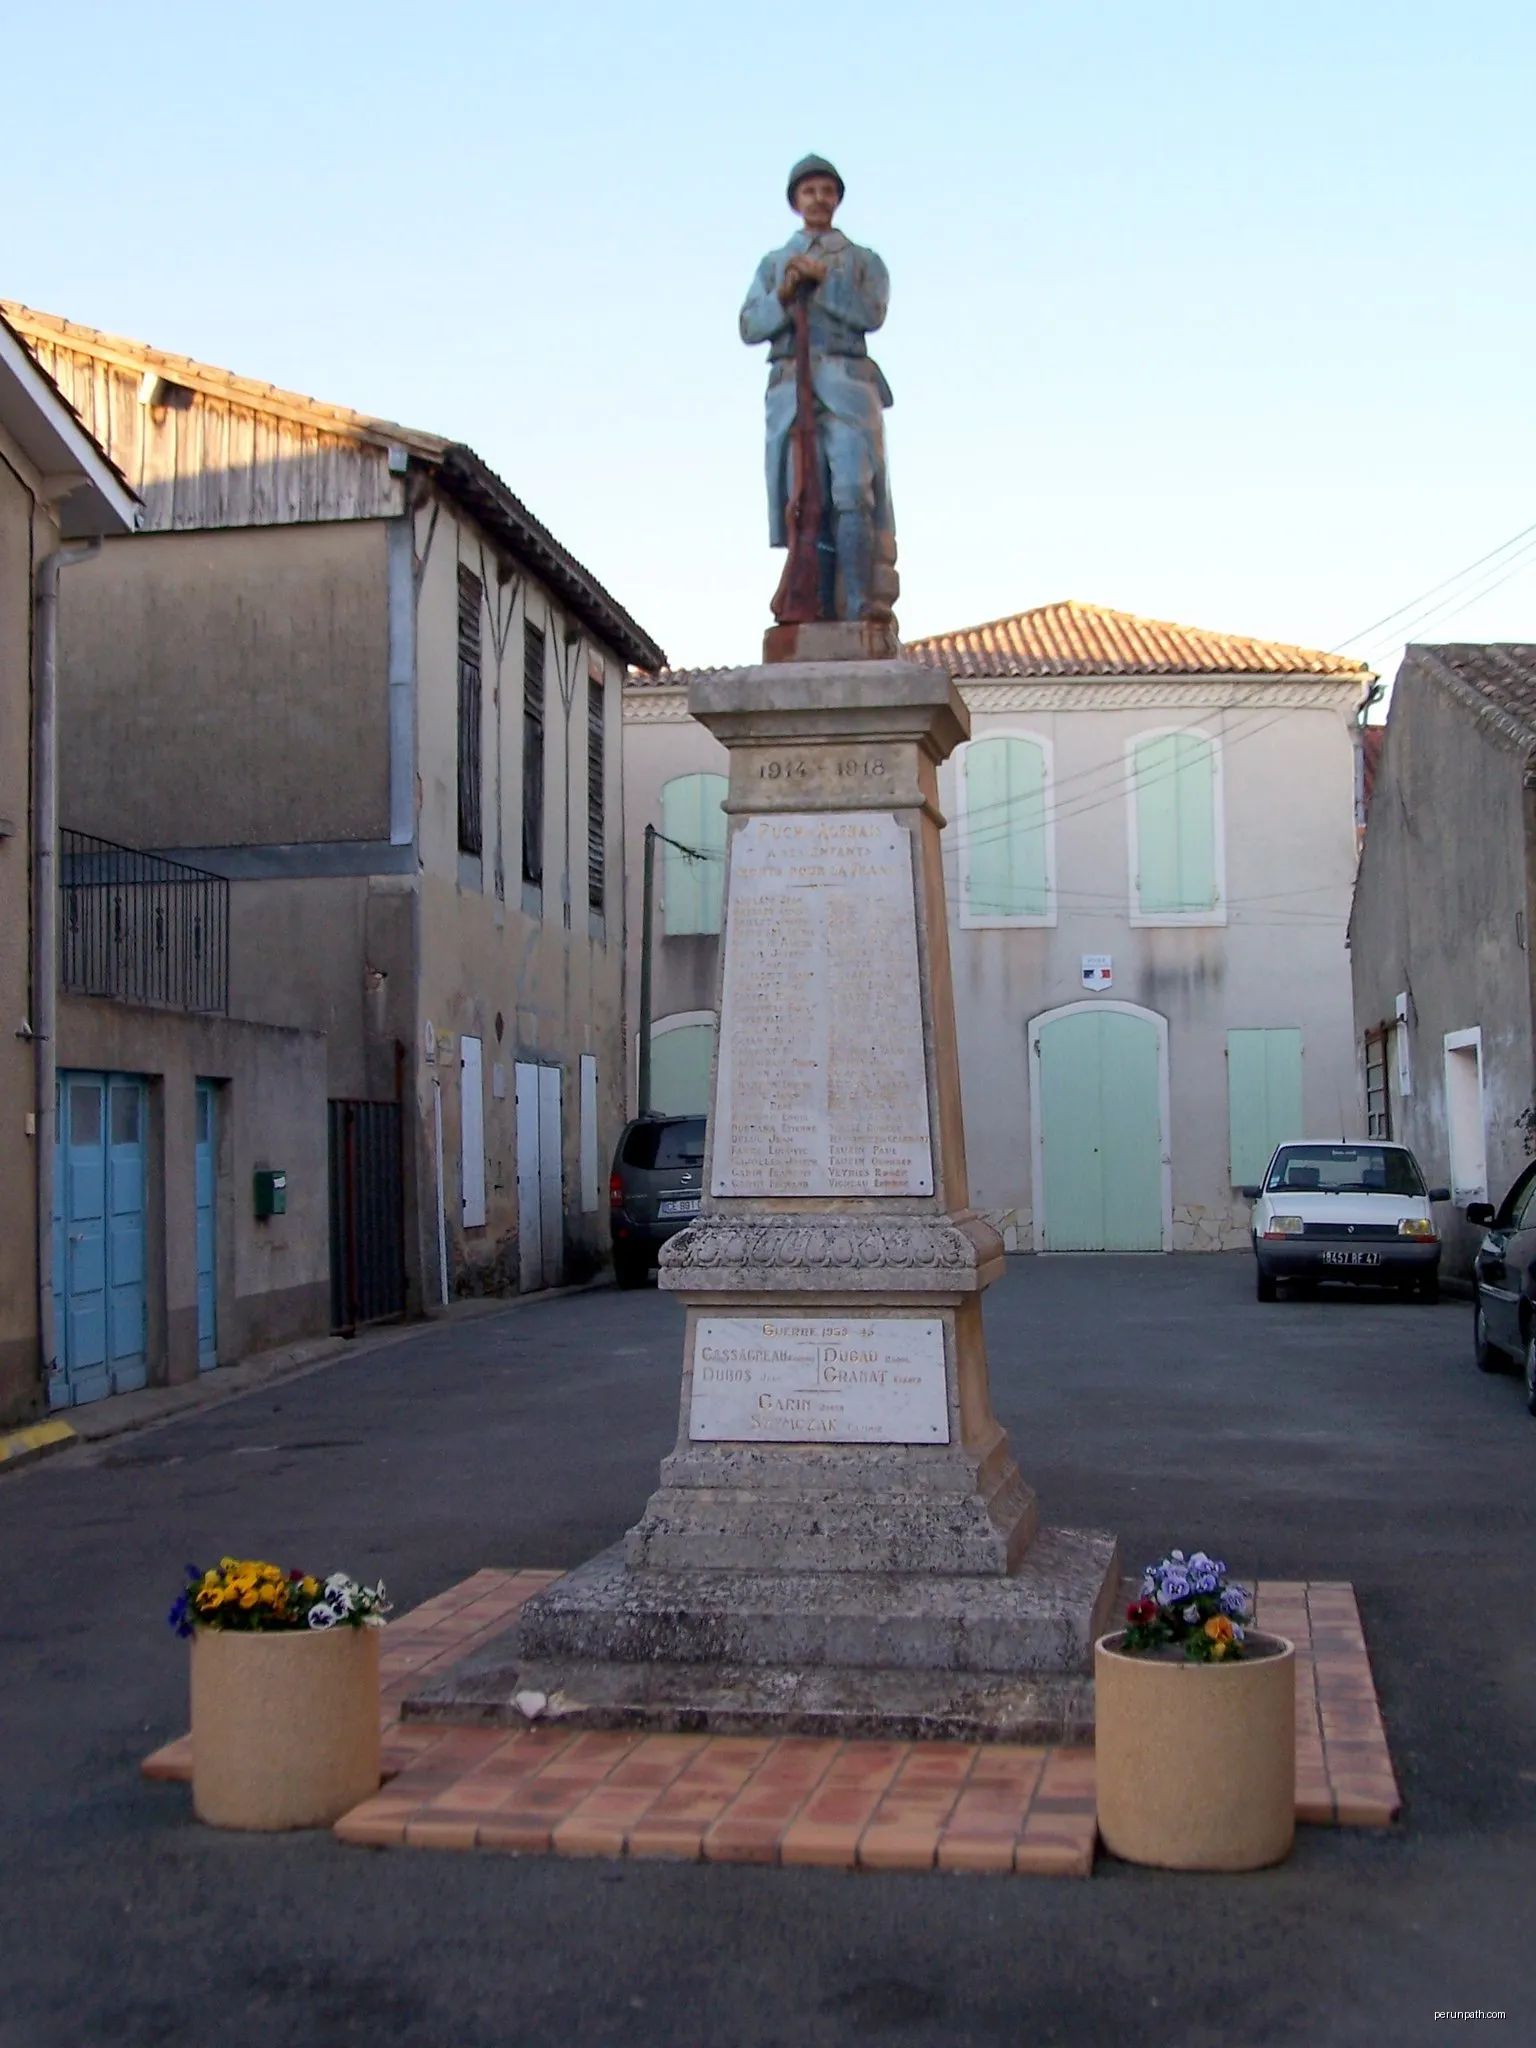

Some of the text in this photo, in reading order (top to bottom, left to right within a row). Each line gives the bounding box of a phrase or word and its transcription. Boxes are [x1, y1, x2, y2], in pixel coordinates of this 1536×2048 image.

[759, 761, 807, 779] 1914
[836, 759, 885, 777] 1918
[762, 1323, 818, 1337] GUERRE
